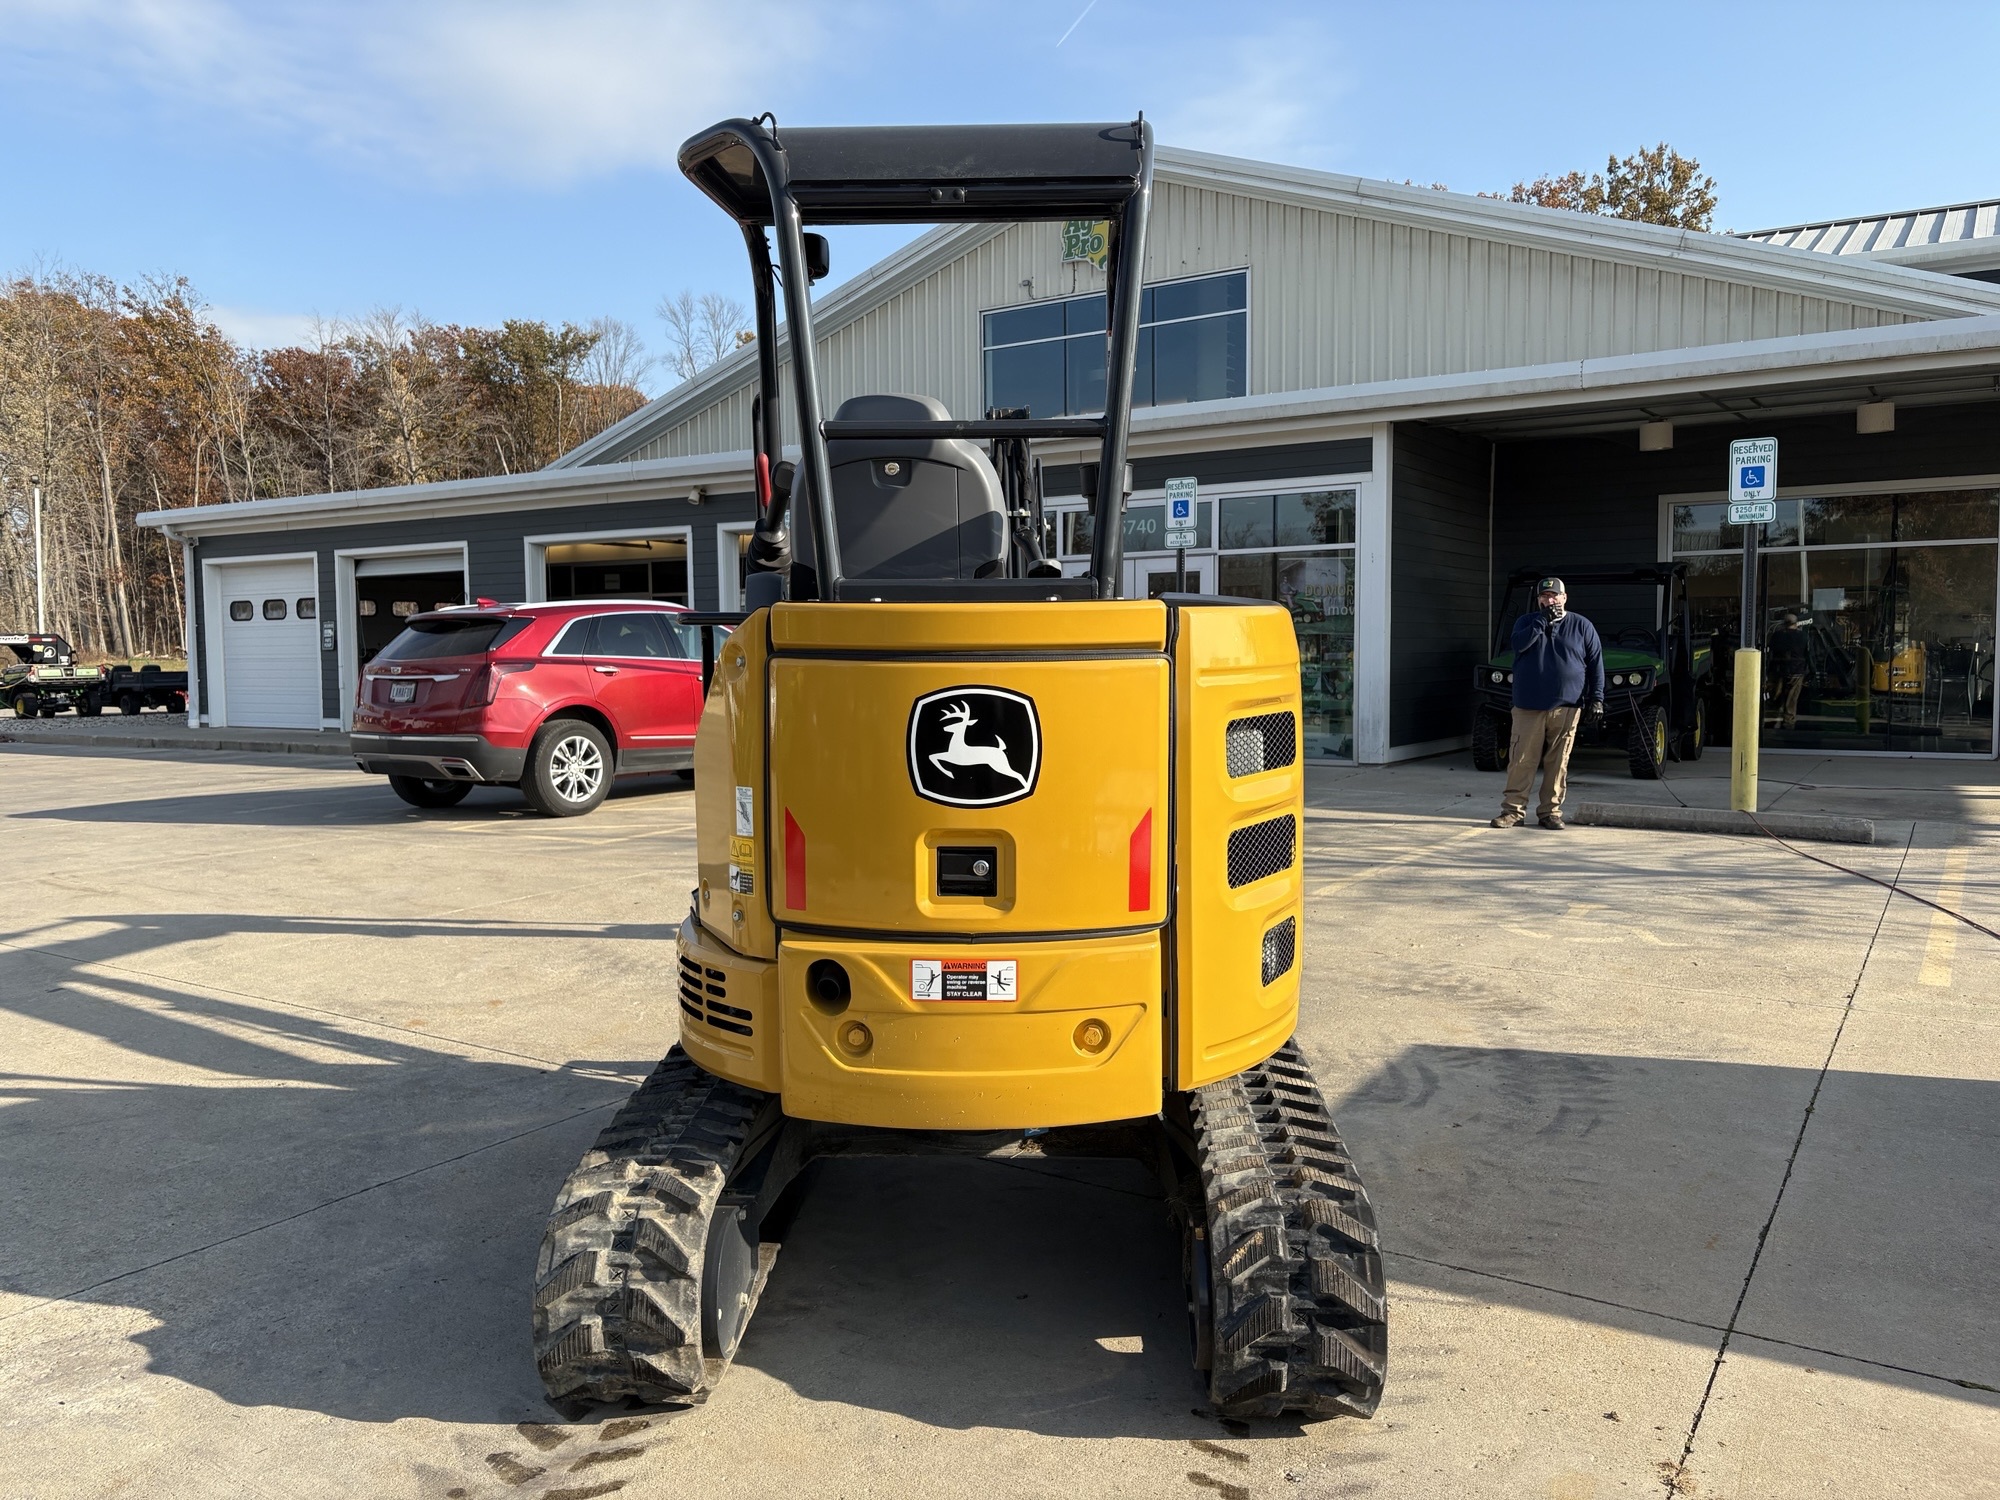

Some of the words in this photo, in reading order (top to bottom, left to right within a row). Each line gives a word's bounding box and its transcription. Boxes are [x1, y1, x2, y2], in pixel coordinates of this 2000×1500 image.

[1064, 234, 1104, 259] Pro
[1733, 444, 1773, 454] RESERVED
[1736, 455, 1771, 464] PARKING
[1168, 482, 1195, 490] RESERVED
[1169, 491, 1193, 499] PARKING
[1743, 490, 1761, 498] ONLY
[1735, 506, 1752, 514] $250
[1738, 512, 1765, 520] MINIMUM
[1305, 584, 1322, 596] DO
